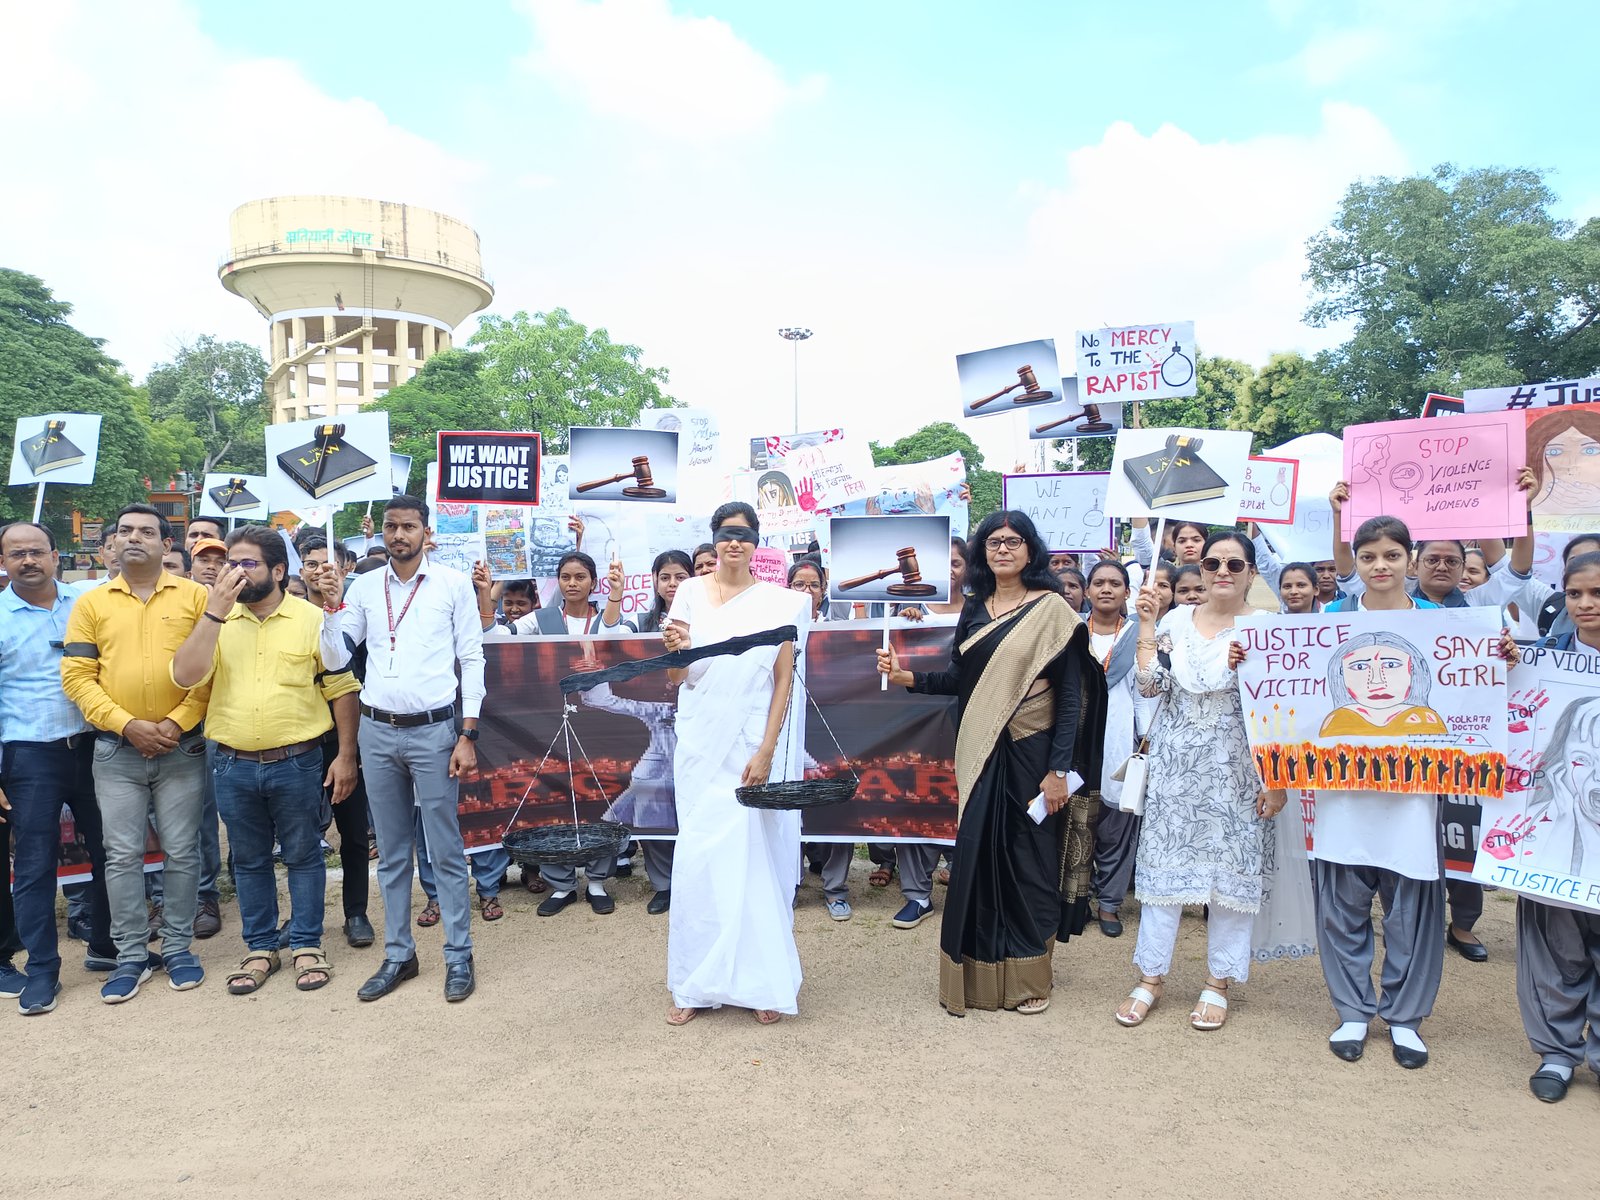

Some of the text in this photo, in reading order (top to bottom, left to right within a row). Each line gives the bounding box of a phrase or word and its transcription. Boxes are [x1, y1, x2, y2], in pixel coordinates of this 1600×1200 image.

[1082, 328, 1171, 348] No MERCY
[1085, 350, 1141, 367] To THE
[1086, 370, 1161, 396] RAPIST
[298, 444, 340, 467] LAW
[449, 445, 530, 465] WE WANT
[1419, 436, 1469, 458] STOP
[1144, 456, 1191, 475] LAW
[1430, 459, 1492, 481] VIOLENCE
[448, 466, 529, 490] JUSTICE
[1424, 480, 1482, 496] AGAINST
[1035, 480, 1061, 498] WE
[1426, 498, 1480, 512] WOMENS
[621, 592, 648, 613] OR
[1241, 624, 1351, 651] JUSTICE
[1433, 635, 1500, 660] SAVE
[1266, 651, 1311, 674] FOR
[1437, 662, 1506, 687] GIRL
[1244, 677, 1327, 700] VICTIM
[1446, 715, 1492, 724] KOLKATA
[1508, 704, 1537, 722] TOP
[1452, 723, 1489, 732] DOCTOR
[1486, 831, 1522, 849] STOP
[1491, 866, 1582, 900] JUSTICE
